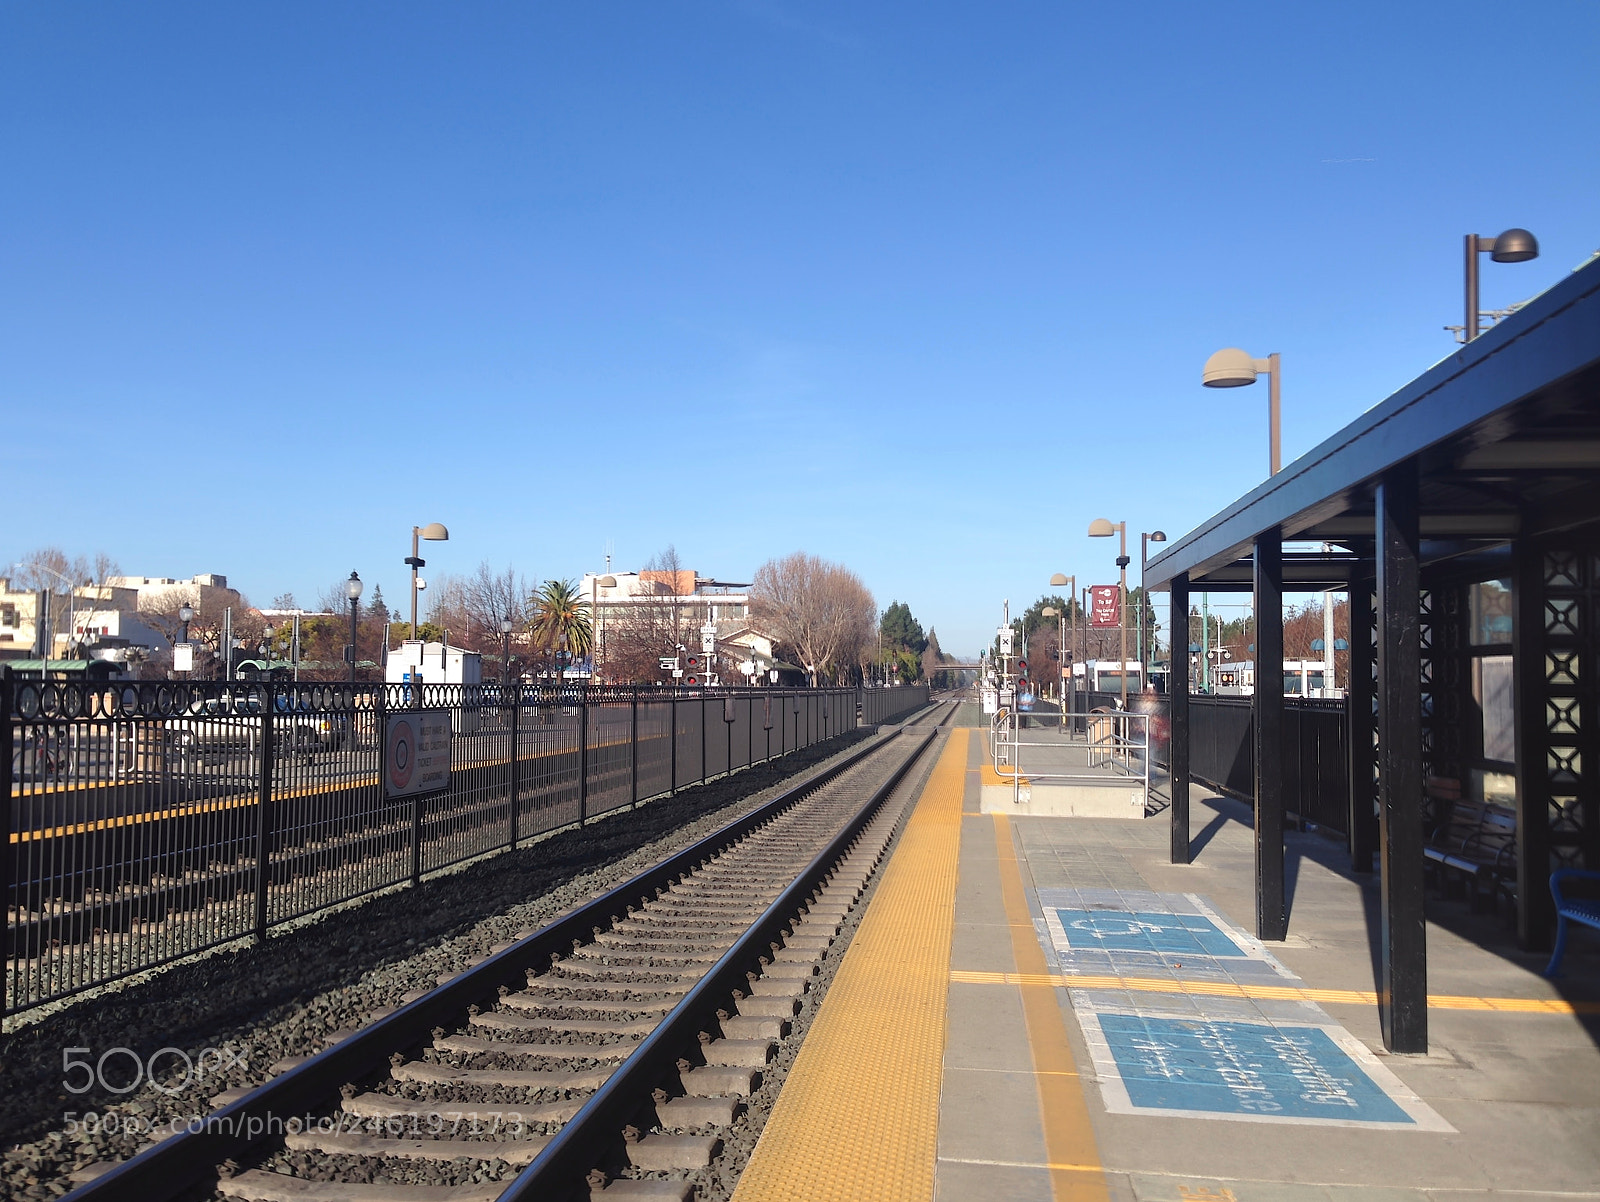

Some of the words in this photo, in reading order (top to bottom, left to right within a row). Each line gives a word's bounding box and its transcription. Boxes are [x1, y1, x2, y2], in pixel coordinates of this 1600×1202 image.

[420, 726, 431, 736] MUST
[418, 742, 430, 752] VALID
[417, 757, 432, 768] TICKET
[1262, 1032, 1360, 1109] Boarding
